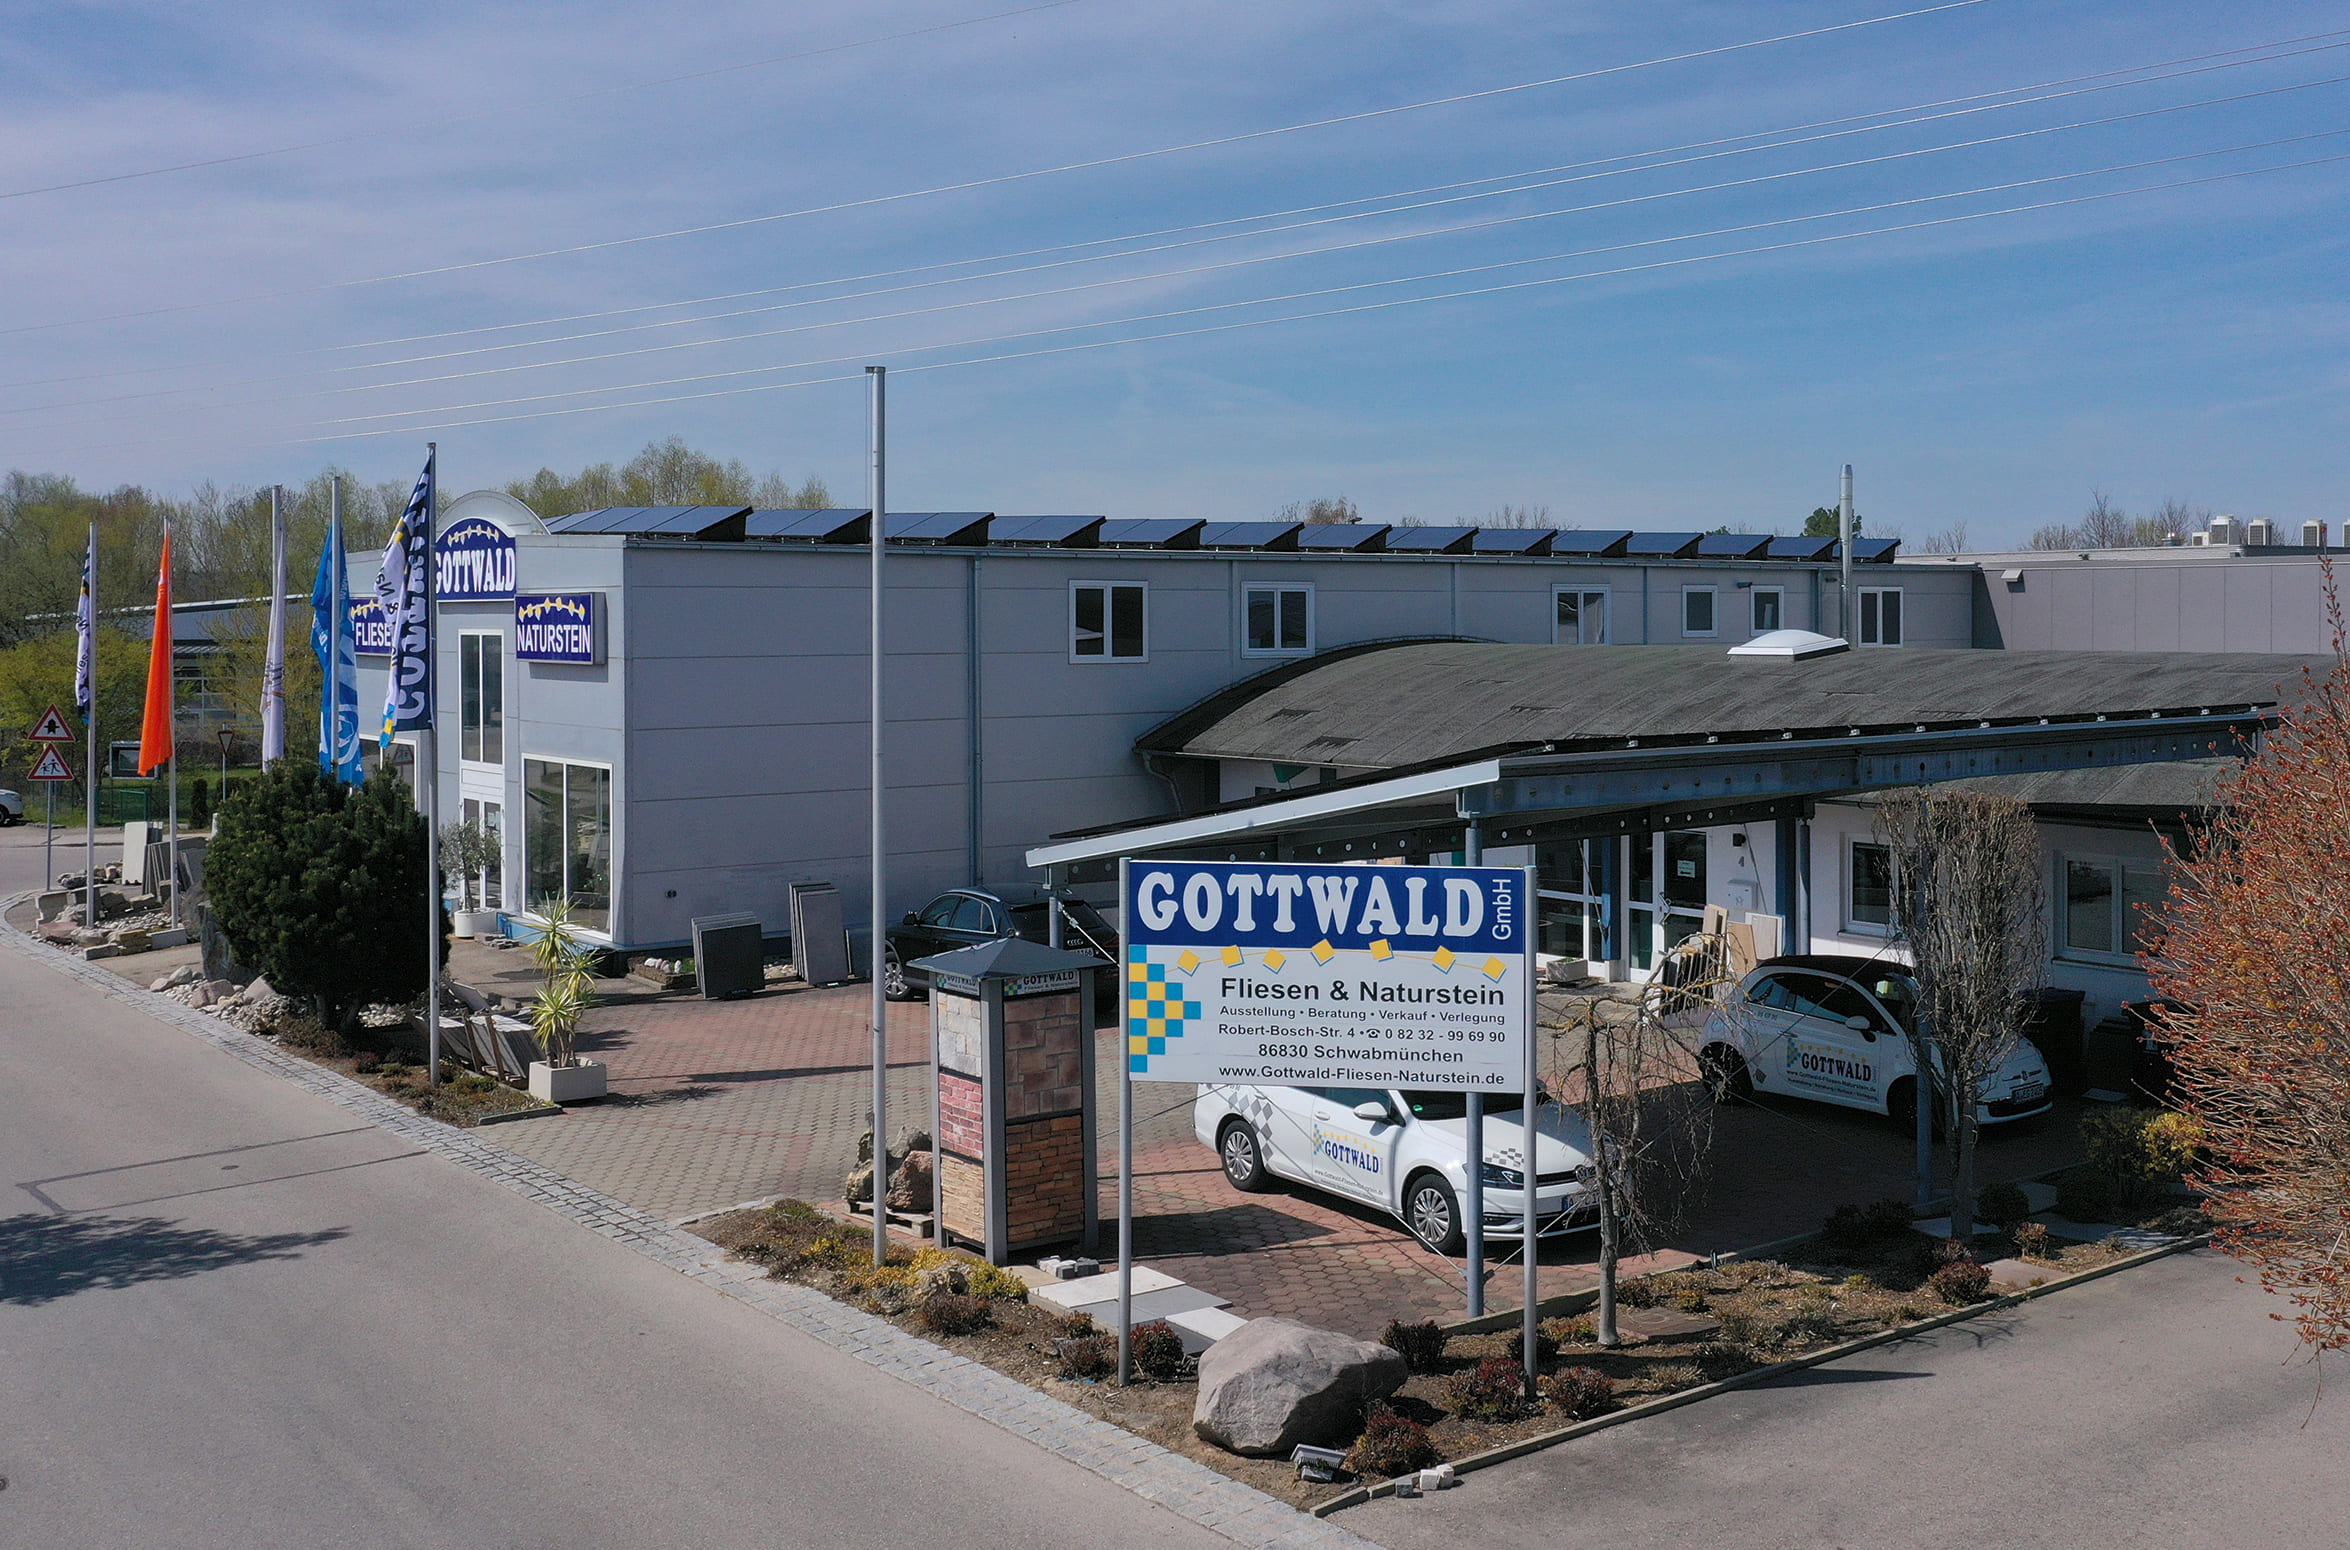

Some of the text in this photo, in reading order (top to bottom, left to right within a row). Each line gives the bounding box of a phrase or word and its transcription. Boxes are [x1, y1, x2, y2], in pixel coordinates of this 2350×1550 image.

[356, 622, 392, 647] FLIESE
[517, 624, 591, 653] NATURSTEIN
[1137, 871, 1484, 937] GOTTWALD
[1492, 879, 1511, 941] GmbH
[1023, 971, 1074, 986] GOTTWALD
[1221, 978, 1504, 1005] Fliesen & Naturstein
[1220, 1006, 1505, 1025] Ausstellung Beratung Verkauf Verlegung
[1219, 1024, 1342, 1038] Robert-Bosch-Str.
[1347, 1028, 1355, 1038] 4
[1385, 1028, 1393, 1039] 0
[1397, 1029, 1413, 1040] 82
[1418, 1030, 1434, 1040] 32
[1447, 1030, 1464, 1041] 99
[1468, 1031, 1484, 1042] 69
[1489, 1032, 1505, 1042] 90
[1258, 1044, 1463, 1062] 86830 Schwabmünchen
[1219, 1065, 1505, 1085] www.Gottwald-Fliesen-Naturstein.de
[1801, 1053, 1872, 1082] GOTTWALD
[1325, 1140, 1379, 1173] GOTTWALD
